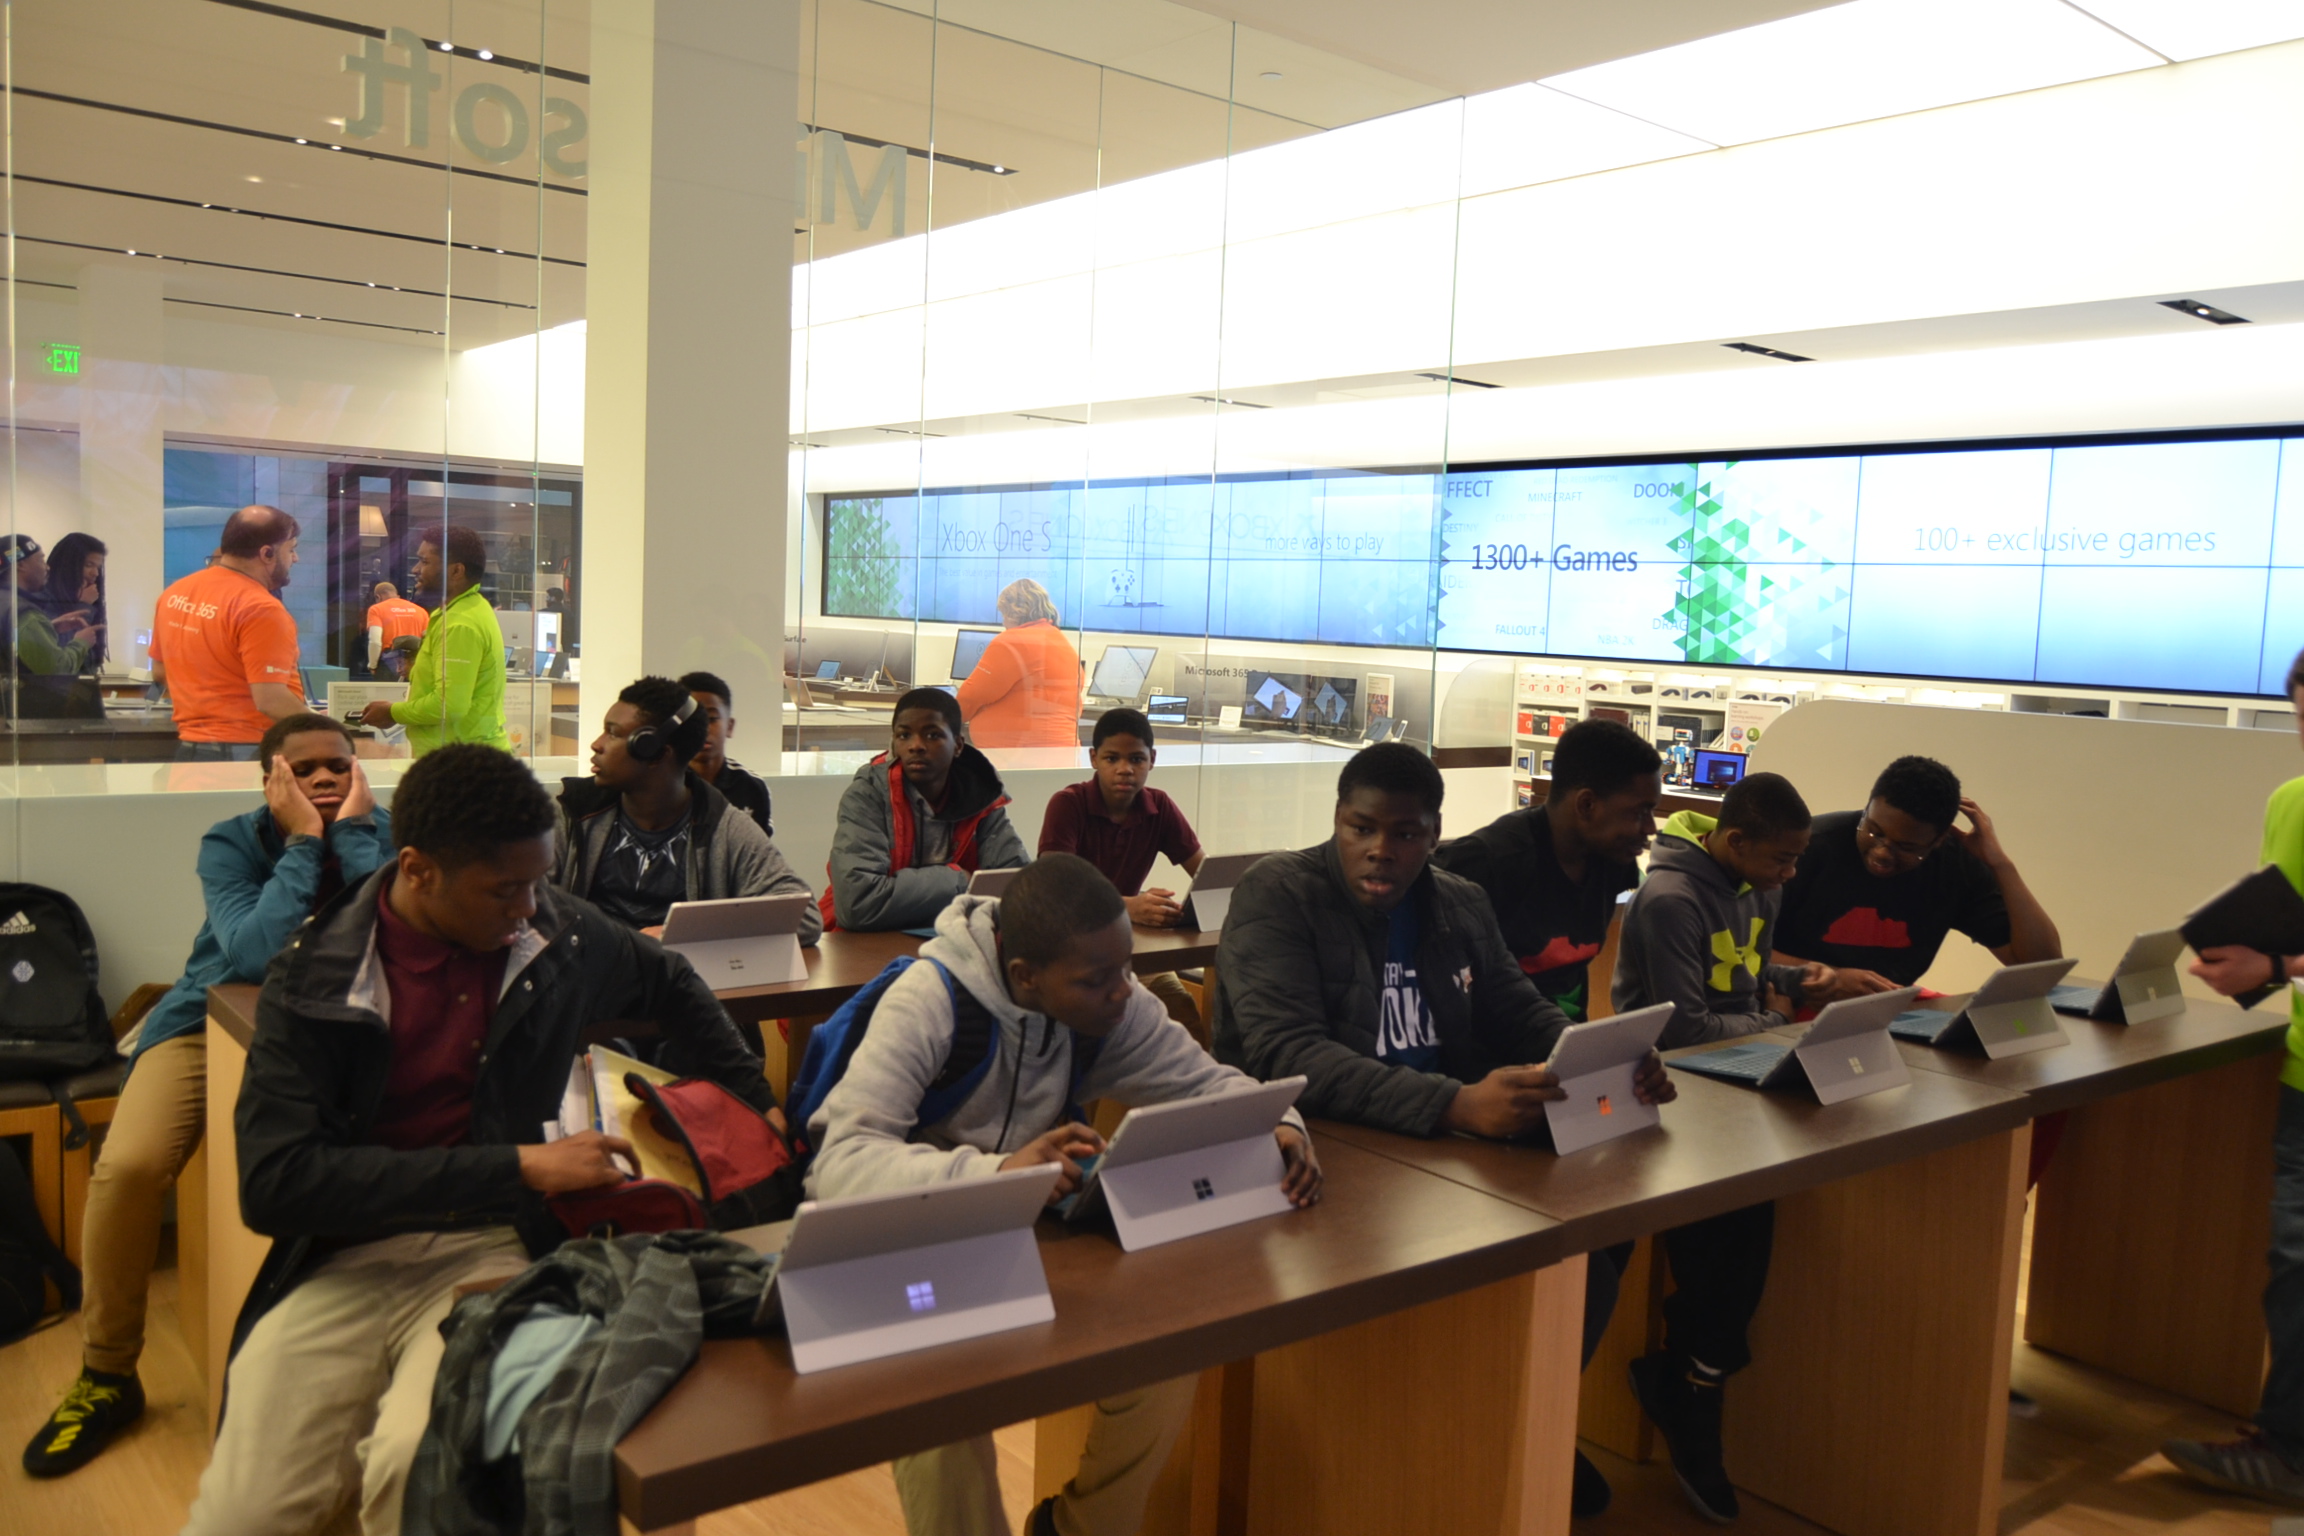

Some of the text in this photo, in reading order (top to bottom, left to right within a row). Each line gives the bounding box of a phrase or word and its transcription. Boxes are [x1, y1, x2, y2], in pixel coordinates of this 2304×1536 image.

[53, 349, 81, 374] EXI
[1528, 491, 1583, 503] MINECRAFT
[941, 520, 1052, 552] Xbox One S
[1265, 535, 1298, 551] more
[1336, 533, 1351, 550] to
[1354, 531, 1385, 555] play
[1914, 525, 2217, 560] 100+ exclusive games
[1472, 543, 1639, 572] 1300+ Games
[167, 594, 219, 620] Office 365
[1495, 624, 1546, 637] FALLOUT 4
[1184, 665, 1230, 678] Microsoft
